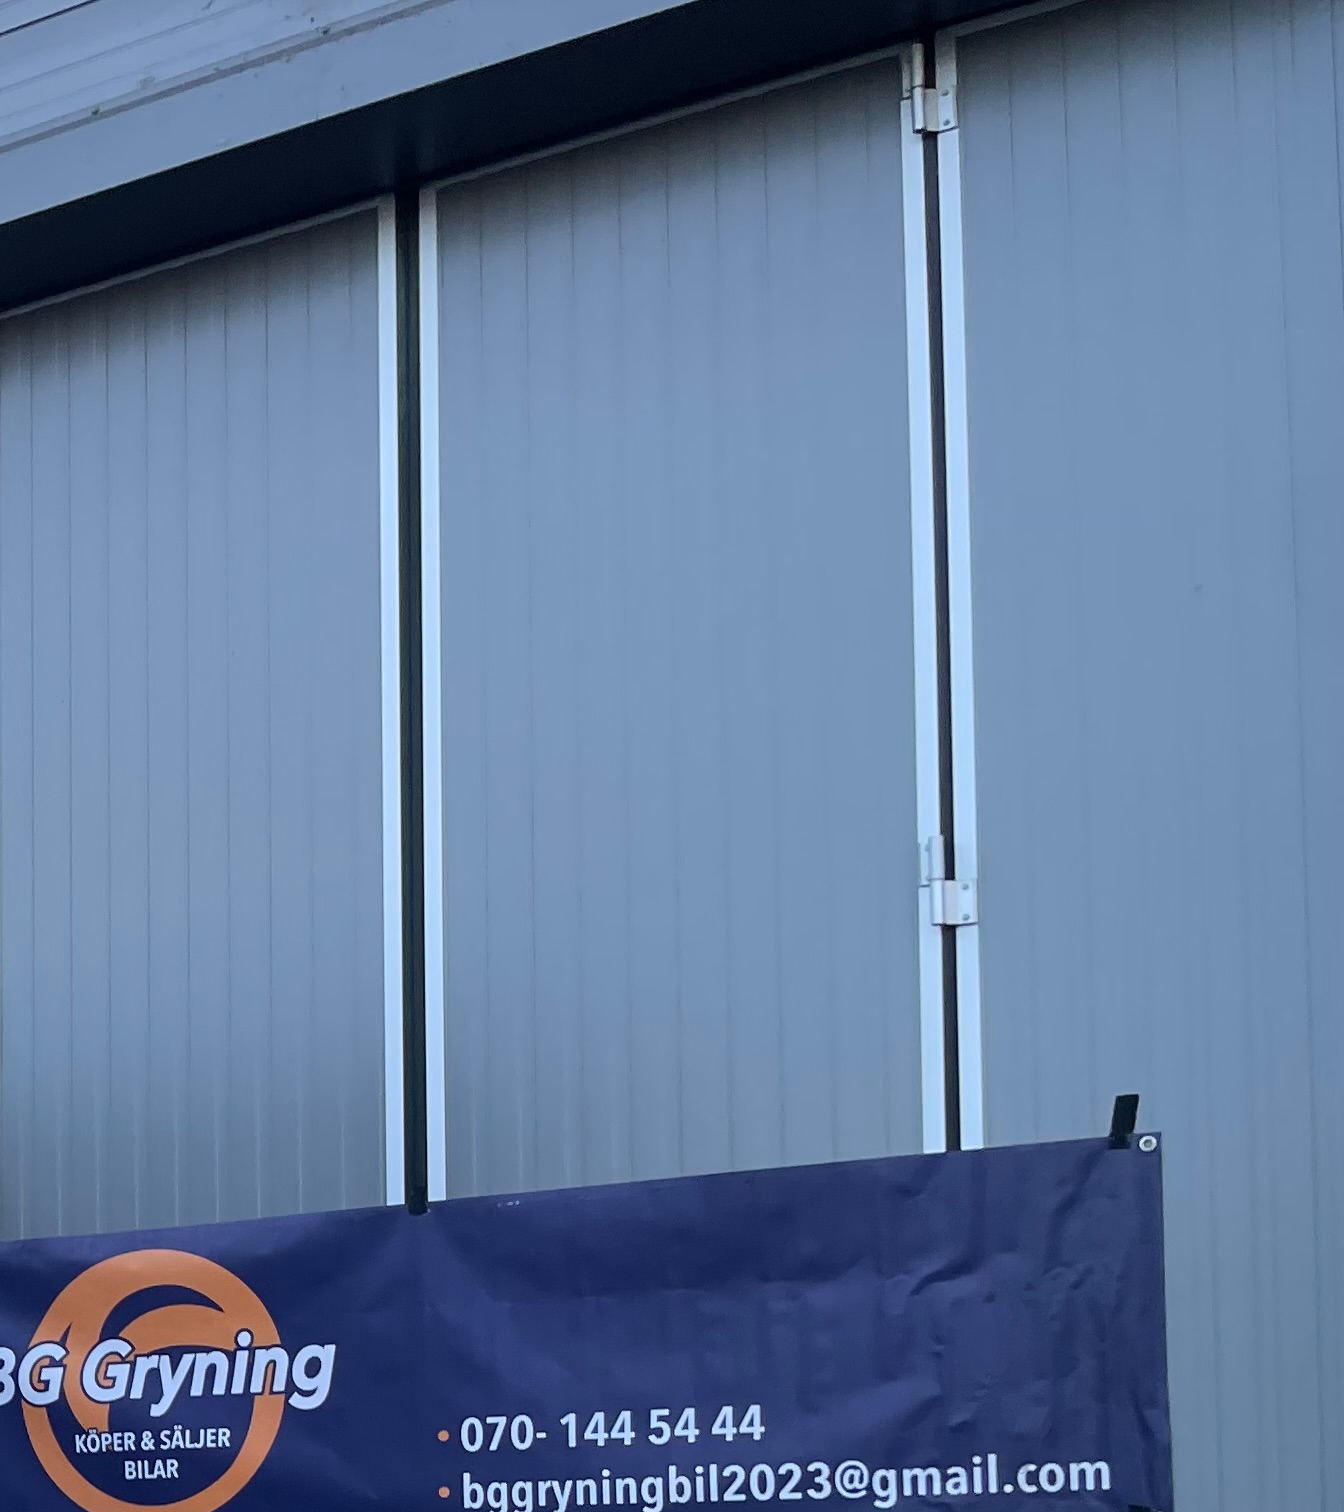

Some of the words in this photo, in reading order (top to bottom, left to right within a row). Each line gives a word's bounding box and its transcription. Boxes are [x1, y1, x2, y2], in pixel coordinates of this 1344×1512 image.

[81, 1328, 337, 1418] Gryning
[74, 1428, 135, 1454] KÖPER
[140, 1430, 155, 1451] &
[159, 1425, 231, 1450] SÄLJER
[461, 1414, 548, 1453] 070-
[559, 1410, 636, 1448] 144
[647, 1407, 700, 1446] 54
[711, 1404, 766, 1442] 44
[124, 1458, 180, 1480] BILAR
